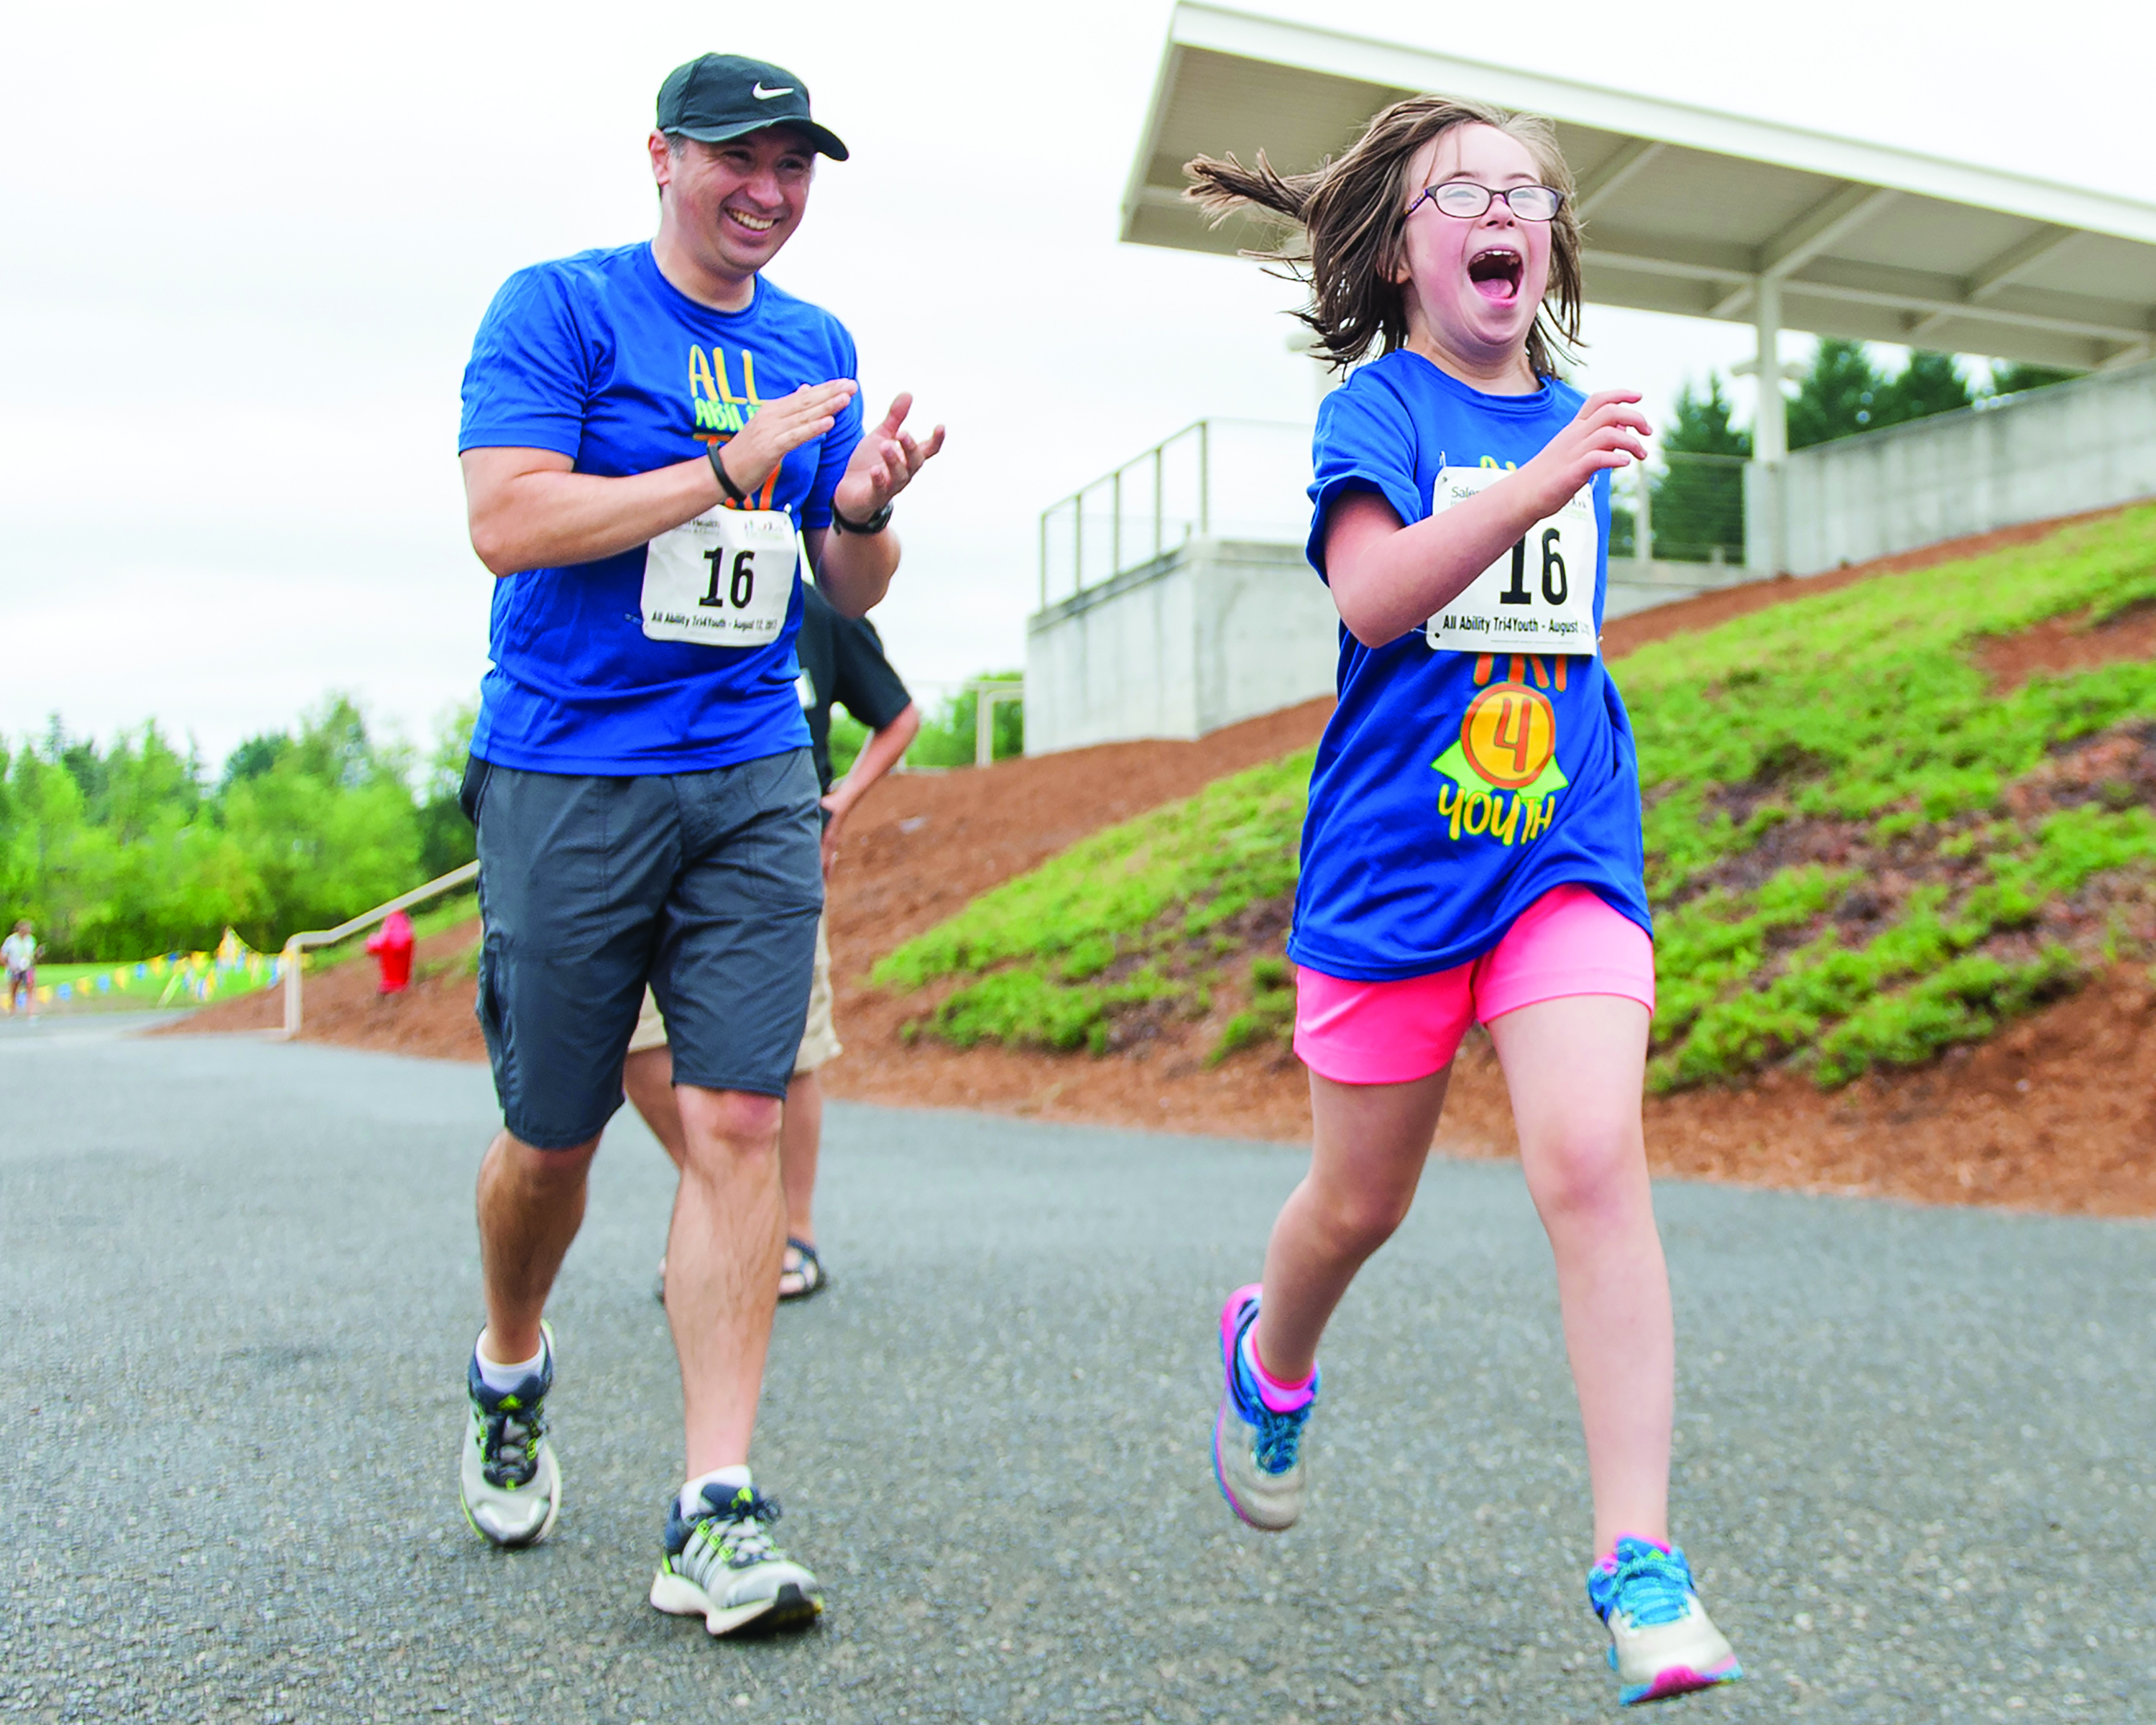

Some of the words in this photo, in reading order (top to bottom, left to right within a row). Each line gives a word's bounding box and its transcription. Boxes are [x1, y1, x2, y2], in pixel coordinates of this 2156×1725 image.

[688, 344, 768, 405] ALL
[694, 397, 760, 432] ABIL
[1451, 486, 1480, 498] Sale
[699, 547, 755, 609] 16
[1500, 528, 1567, 605] 16
[651, 610, 663, 622] All
[664, 612, 690, 627] Ability
[1443, 615, 1457, 630] All
[1459, 615, 1491, 634] Ability
[1493, 617, 1539, 632] Tri4Youth
[1548, 618, 1578, 637] August
[1494, 697, 1531, 773] 4
[1438, 783, 1555, 845] YOUTH
